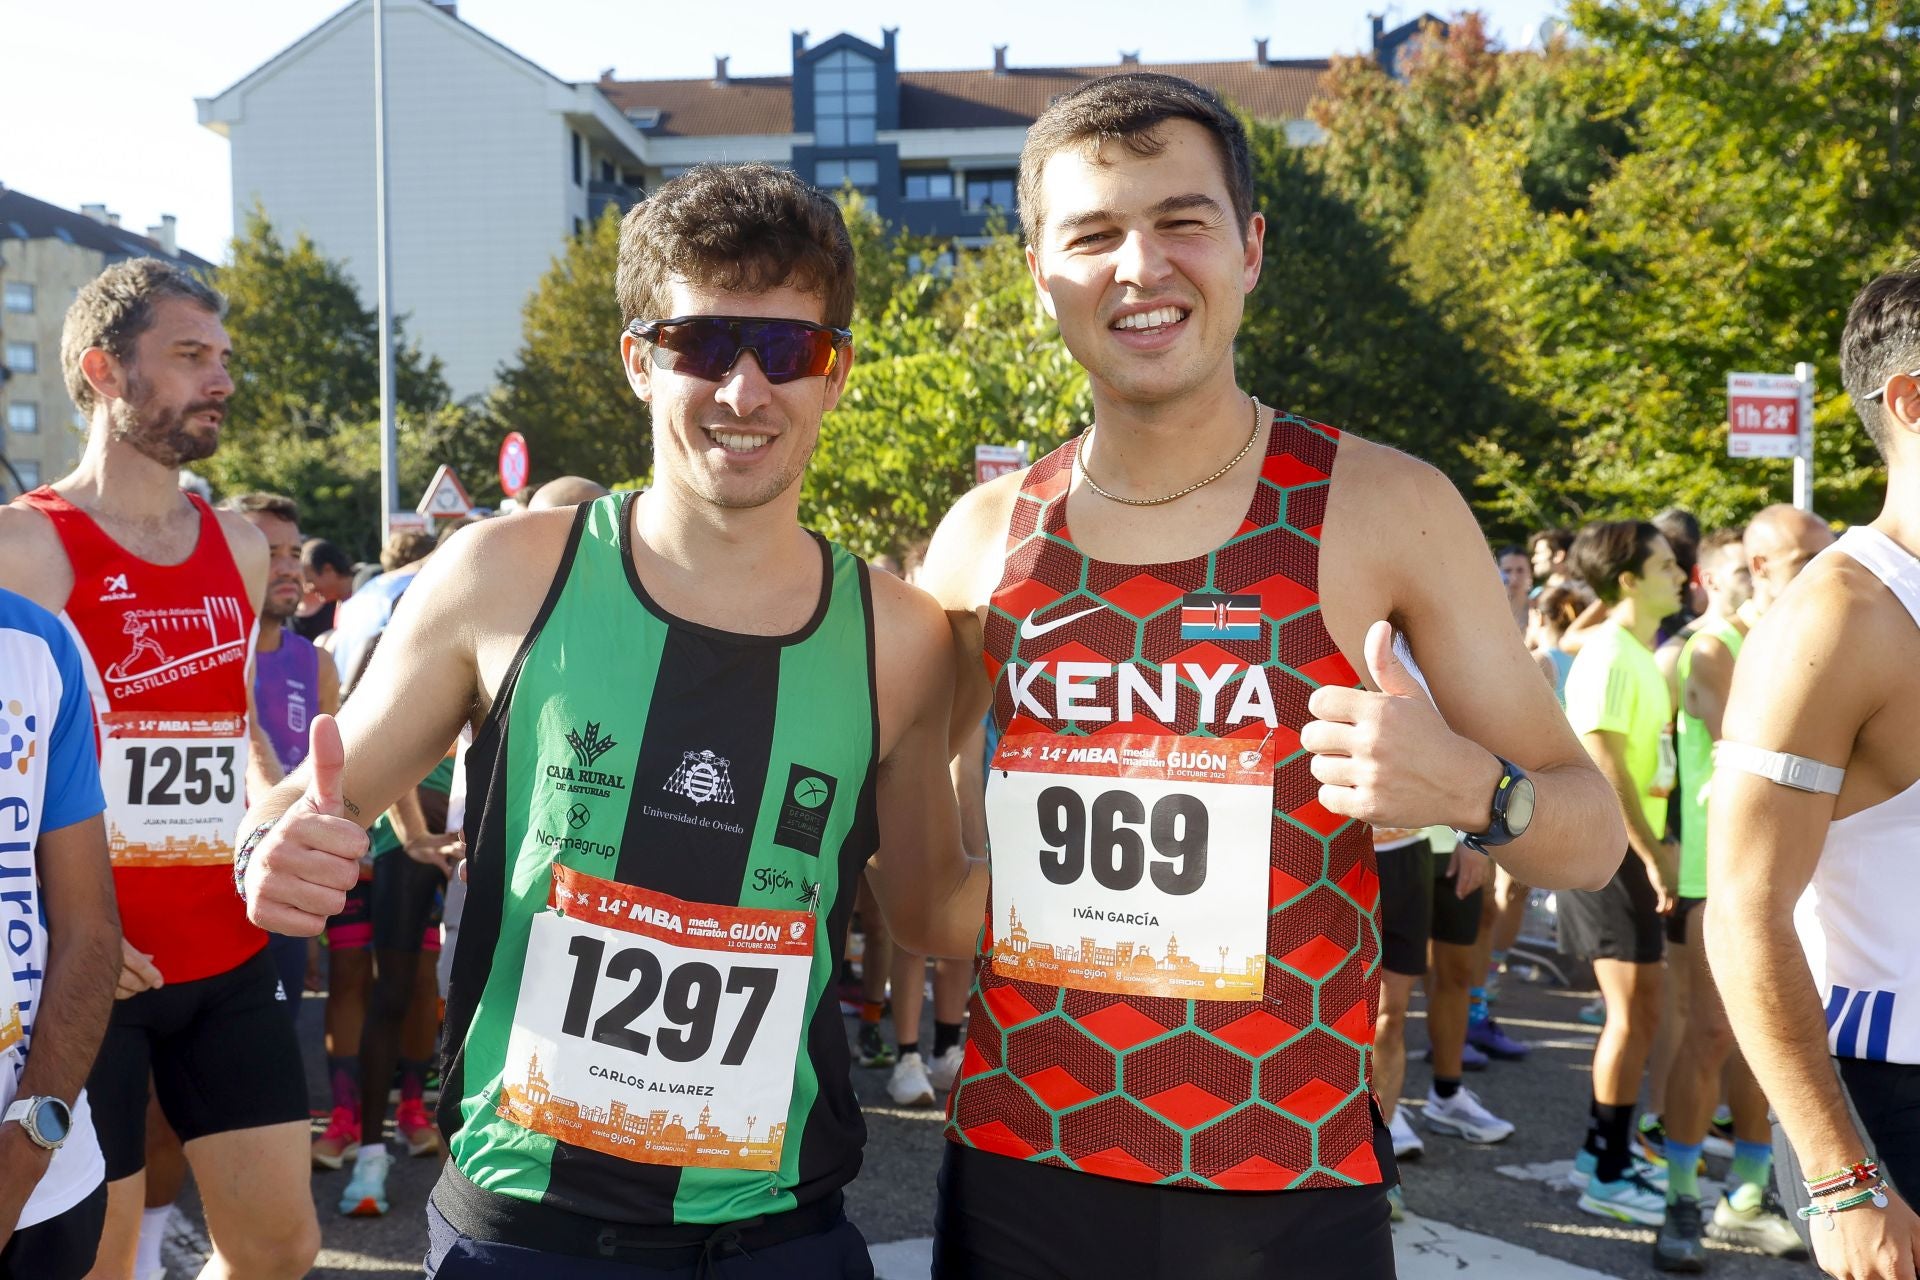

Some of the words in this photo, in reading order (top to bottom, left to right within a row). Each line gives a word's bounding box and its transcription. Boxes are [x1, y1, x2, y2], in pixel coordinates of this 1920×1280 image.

[113, 668, 180, 699] CASTILLO
[179, 662, 198, 679] DE
[199, 656, 218, 672] LA
[1007, 660, 1279, 728] KENYA
[157, 720, 190, 732] MBA
[1066, 747, 1119, 764] MBA
[1122, 747, 1157, 758] media
[1167, 750, 1227, 771] GIJÓN
[1122, 756, 1166, 768] maratón
[125, 746, 236, 807] 1253
[546, 765, 575, 781] CAJA
[577, 769, 626, 789] RURAL
[1176, 769, 1208, 778] OCTUBRE
[1209, 771, 1226, 779] 2025
[555, 782, 567, 791] DE
[567, 784, 611, 798] ASTURIAS
[642, 805, 699, 829] Universidad
[699, 817, 711, 829] de
[712, 819, 745, 835] Oviedo
[536, 828, 616, 860] Normagrup
[1036, 785, 1210, 897] 969
[752, 867, 794, 895] gijón
[628, 903, 683, 934] MBA
[1073, 906, 1104, 921] IVÁN
[1107, 911, 1160, 927] GARCÍA
[687, 926, 728, 939] maratón
[688, 917, 720, 929] media
[729, 921, 781, 942] GIJÓN
[736, 941, 763, 949] OCTUBRE
[763, 942, 777, 950] 2025
[1067, 967, 1083, 976] visita
[1083, 968, 1107, 980] gijón
[1168, 978, 1205, 987] SIROKO
[561, 934, 779, 1067] 1297
[588, 1064, 645, 1090] CARLOS
[647, 1081, 715, 1098] ALVAREZ
[555, 1116, 583, 1130] TRIOCAR
[591, 1128, 610, 1139] visita
[610, 1131, 636, 1146] gijón
[696, 1147, 730, 1156] SIROKO
